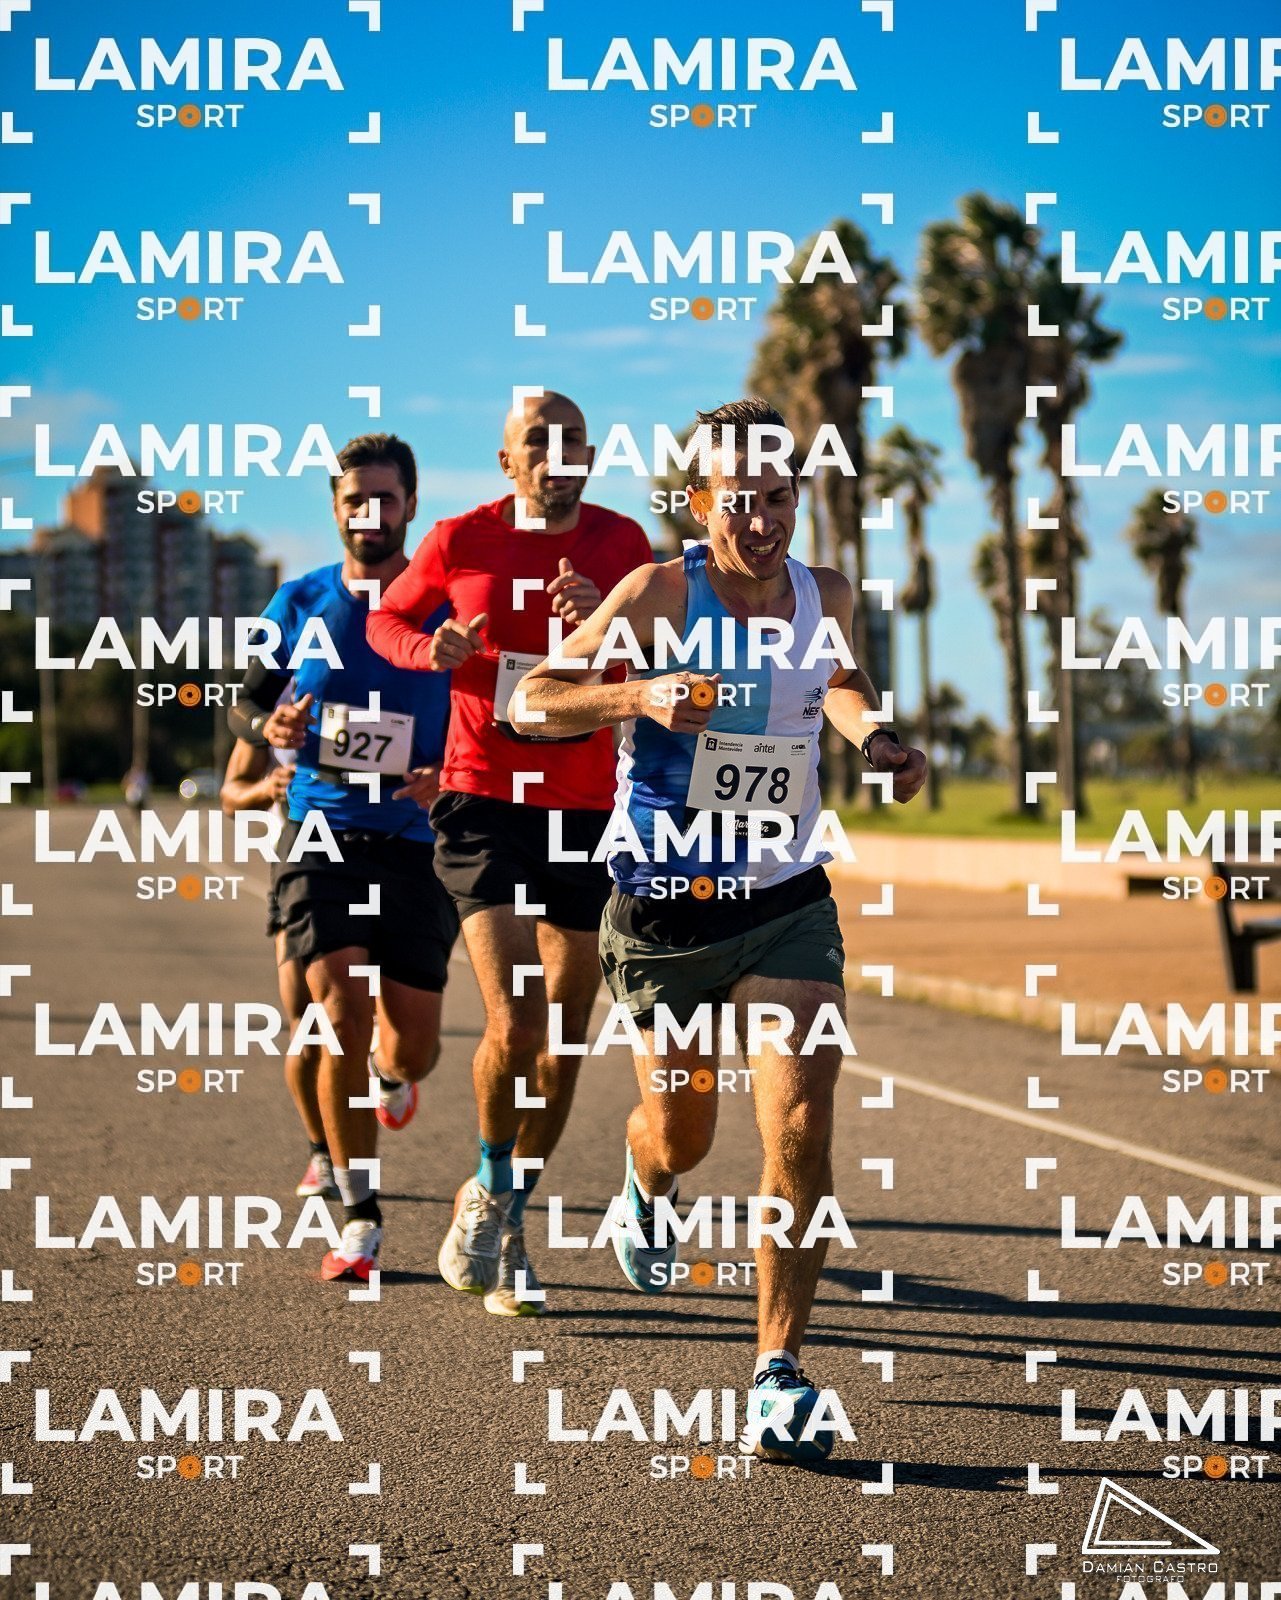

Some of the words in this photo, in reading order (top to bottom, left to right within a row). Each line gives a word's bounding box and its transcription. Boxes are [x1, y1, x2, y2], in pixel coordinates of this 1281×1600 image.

[333, 728, 393, 763] 927
[754, 742, 775, 753] antel
[714, 763, 790, 805] 978
